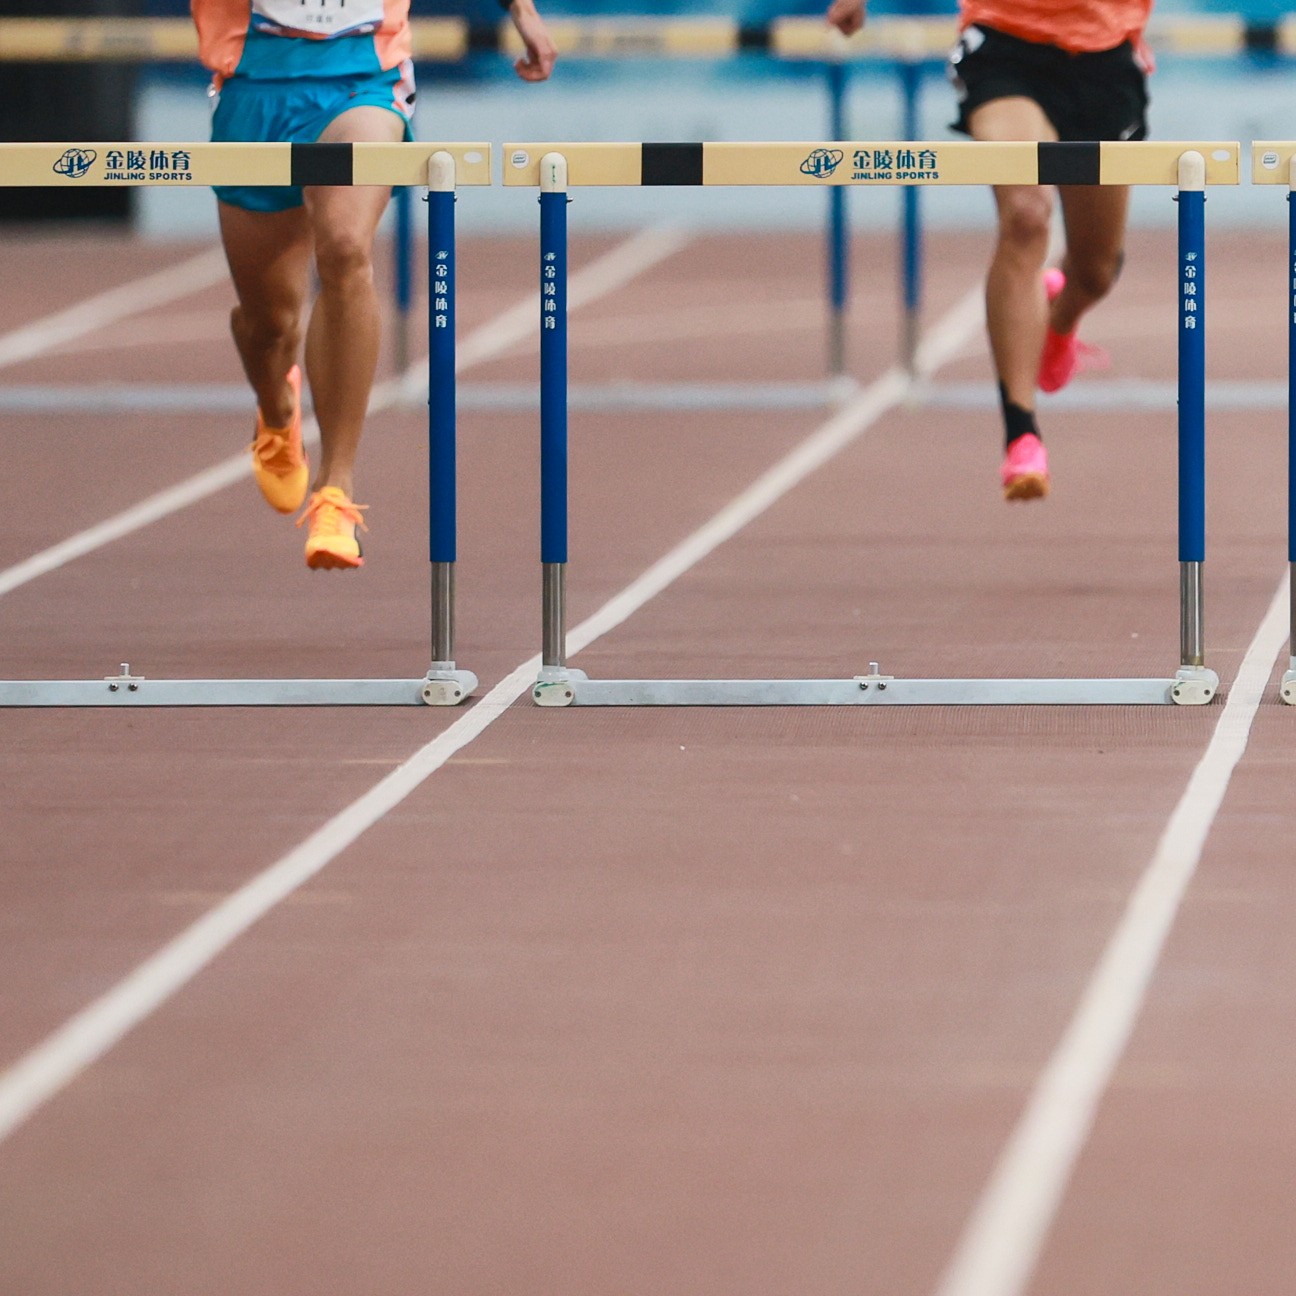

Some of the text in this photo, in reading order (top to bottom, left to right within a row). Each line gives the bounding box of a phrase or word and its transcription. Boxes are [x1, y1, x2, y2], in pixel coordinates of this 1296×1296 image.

[105, 150, 191, 170] 金陵体育
[852, 150, 938, 170] 金陵体育
[435, 264, 448, 328] 金陵体育
[544, 265, 556, 330] 金陵体育
[1184, 265, 1197, 330] 金陵体育
